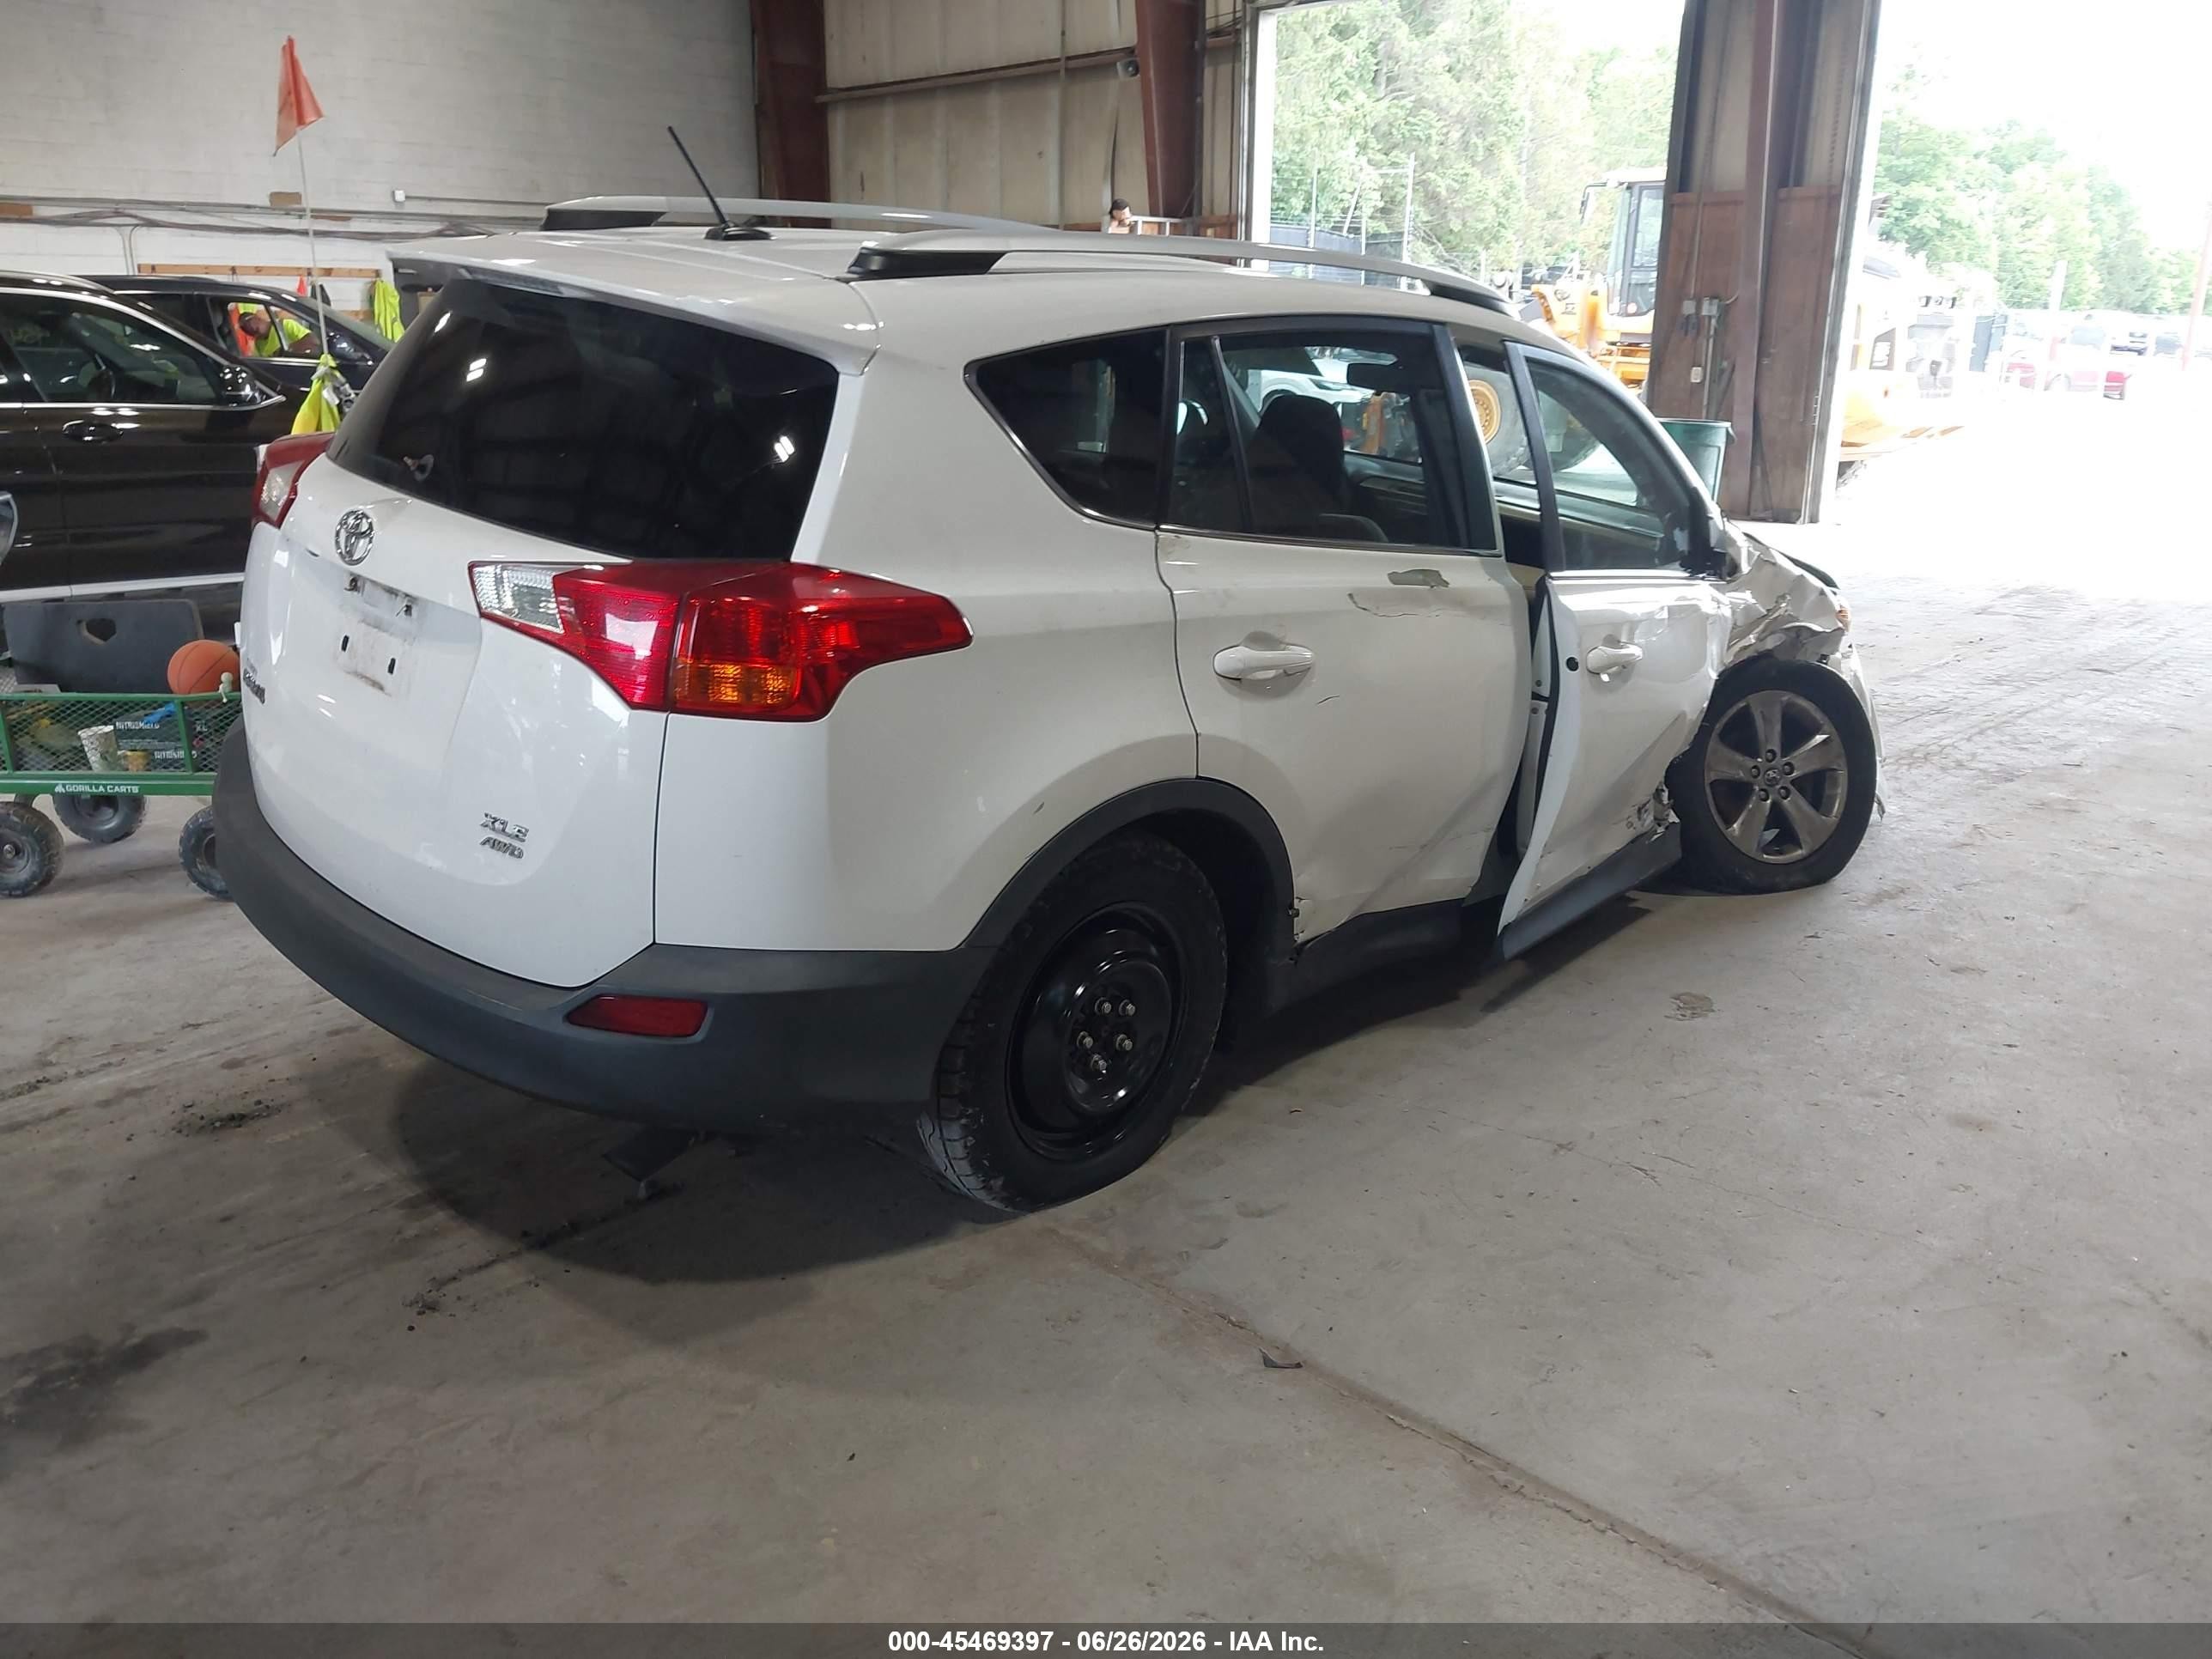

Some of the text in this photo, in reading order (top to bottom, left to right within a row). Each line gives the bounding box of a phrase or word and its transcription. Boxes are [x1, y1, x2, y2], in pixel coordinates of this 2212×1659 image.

[65, 784, 140, 794] GORILLA CARTS
[480, 812, 530, 843] XLE
[479, 836, 525, 860] AWD
